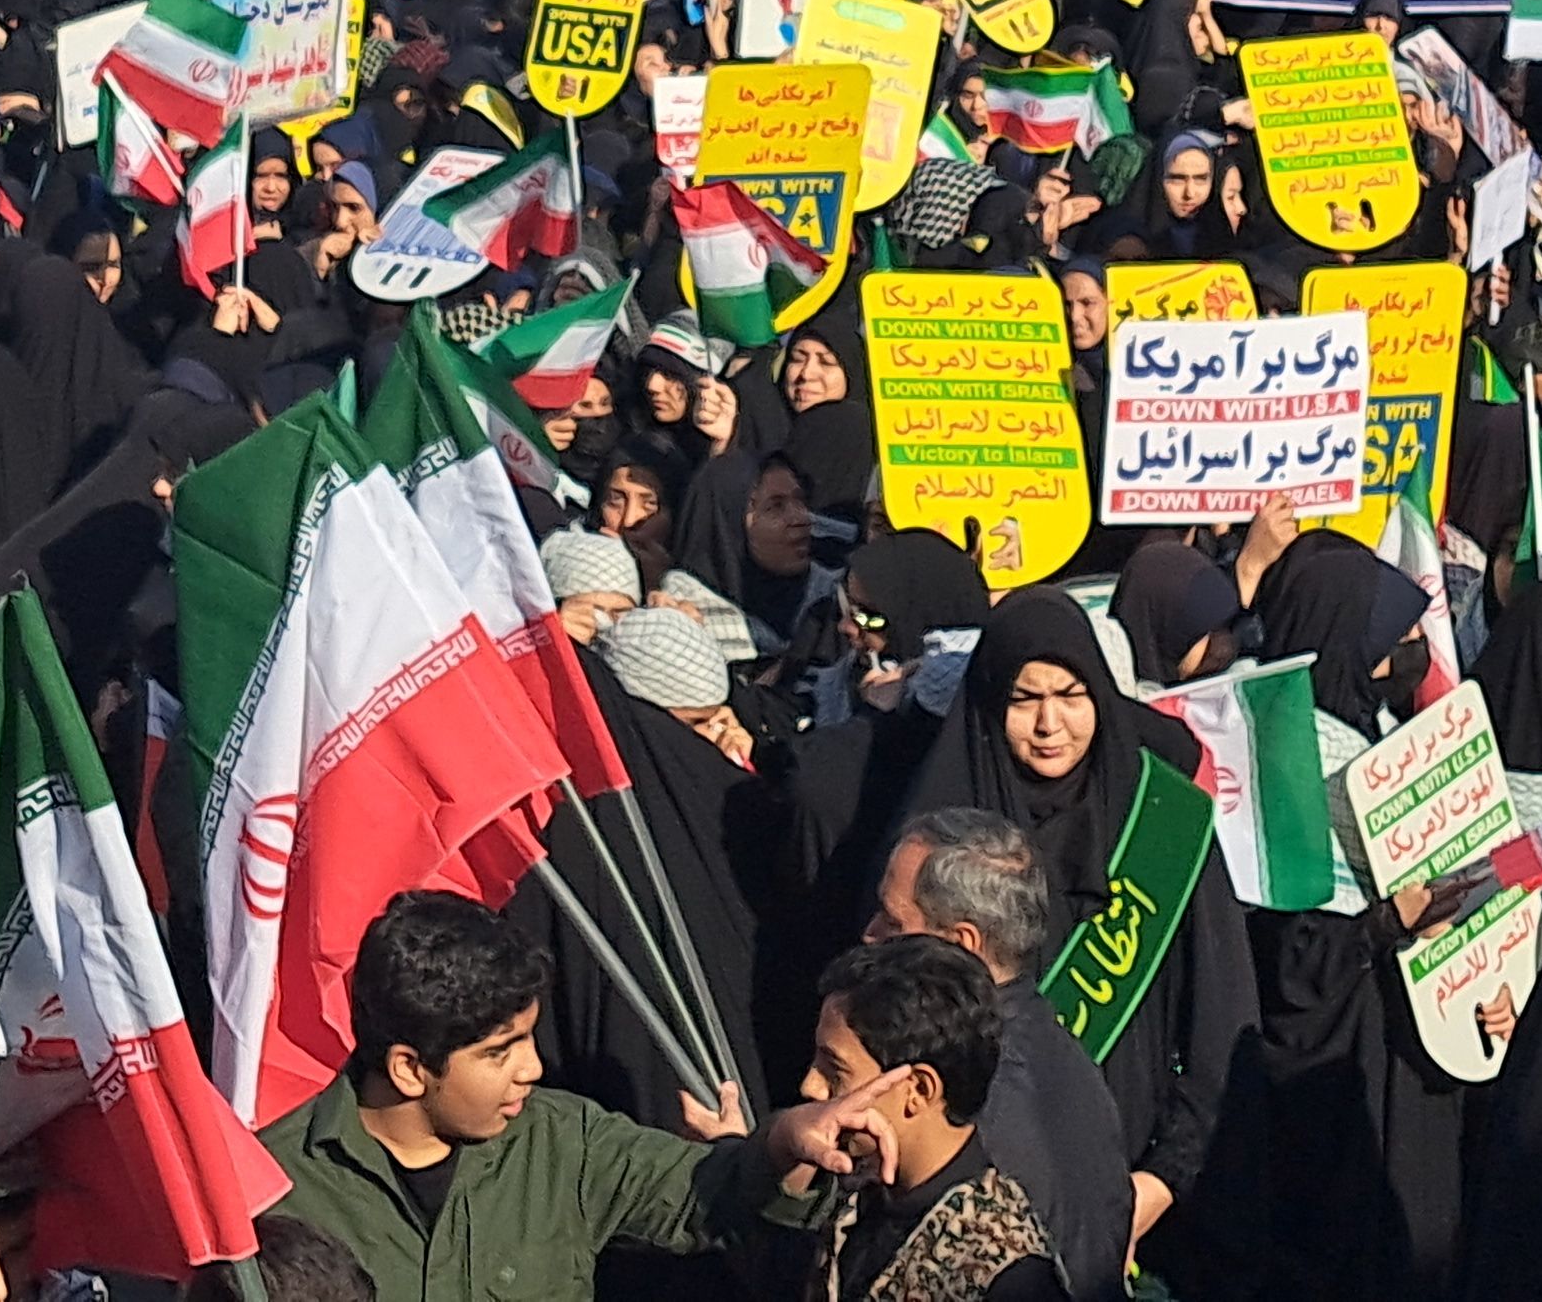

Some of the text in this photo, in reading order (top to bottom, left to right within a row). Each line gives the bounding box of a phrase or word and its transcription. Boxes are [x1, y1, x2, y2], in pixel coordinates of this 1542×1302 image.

[542, 21, 617, 68] USA
[1338, 42, 1375, 61] مرگ
[1304, 69, 1341, 83] WITH
[1332, 82, 1382, 105] الموت
[1308, 110, 1342, 124] WITH
[1346, 123, 1396, 147] الموت
[740, 178, 835, 196] OWN WITH
[963, 296, 984, 316] بر
[990, 286, 1038, 317] مرگ
[879, 321, 940, 337] DOWN
[945, 322, 998, 339] WITH
[984, 349, 1050, 378] الموت
[1124, 329, 1359, 394] مرگ بر آمریکا
[884, 381, 1066, 402] DOWN WITH ISRAEL
[1131, 400, 1216, 421] DOWN
[1223, 398, 1287, 420] WITH
[1385, 401, 1432, 421] WITH
[997, 410, 1065, 442] الموت
[903, 444, 1064, 465] Victory to Islam
[1117, 424, 1357, 483] مرگ بر اسرائیل
[1363, 422, 1422, 488] SA
[914, 472, 995, 513] للاسلام
[1122, 491, 1201, 511] DOWN
[1206, 490, 1268, 510] WITH
[1440, 702, 1473, 741] مرگ
[1423, 730, 1441, 764] بر
[1369, 790, 1413, 832] DOWN
[1415, 764, 1452, 799] WITH
[1450, 763, 1495, 817] الموت
[1430, 836, 1464, 876] WITH
[1465, 805, 1509, 852] ISRAEL
[1418, 928, 1469, 973] Victory
